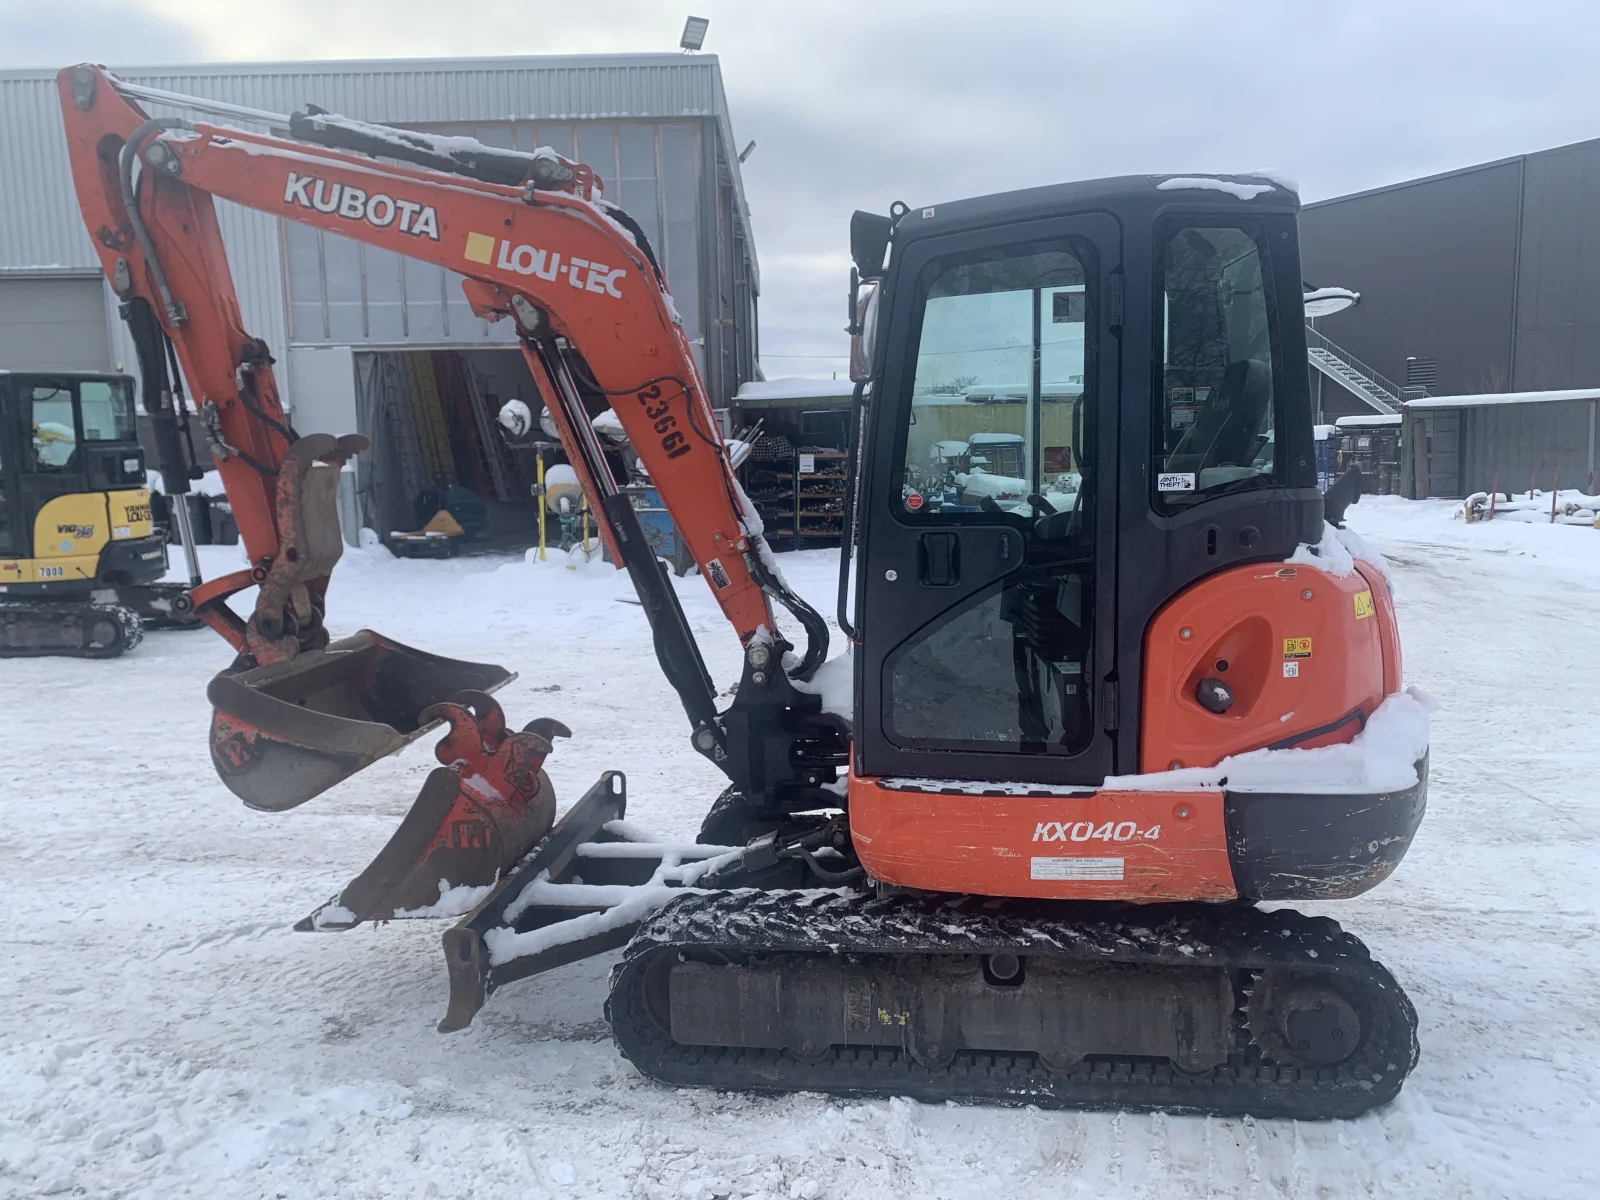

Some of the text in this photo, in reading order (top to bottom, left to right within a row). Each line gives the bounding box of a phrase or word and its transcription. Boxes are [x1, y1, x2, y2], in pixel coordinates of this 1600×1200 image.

[284, 172, 440, 242] KUBOTA
[636, 385, 691, 459] 23661
[40, 567, 64, 577] 7000
[1032, 821, 1161, 841] KX040-4
